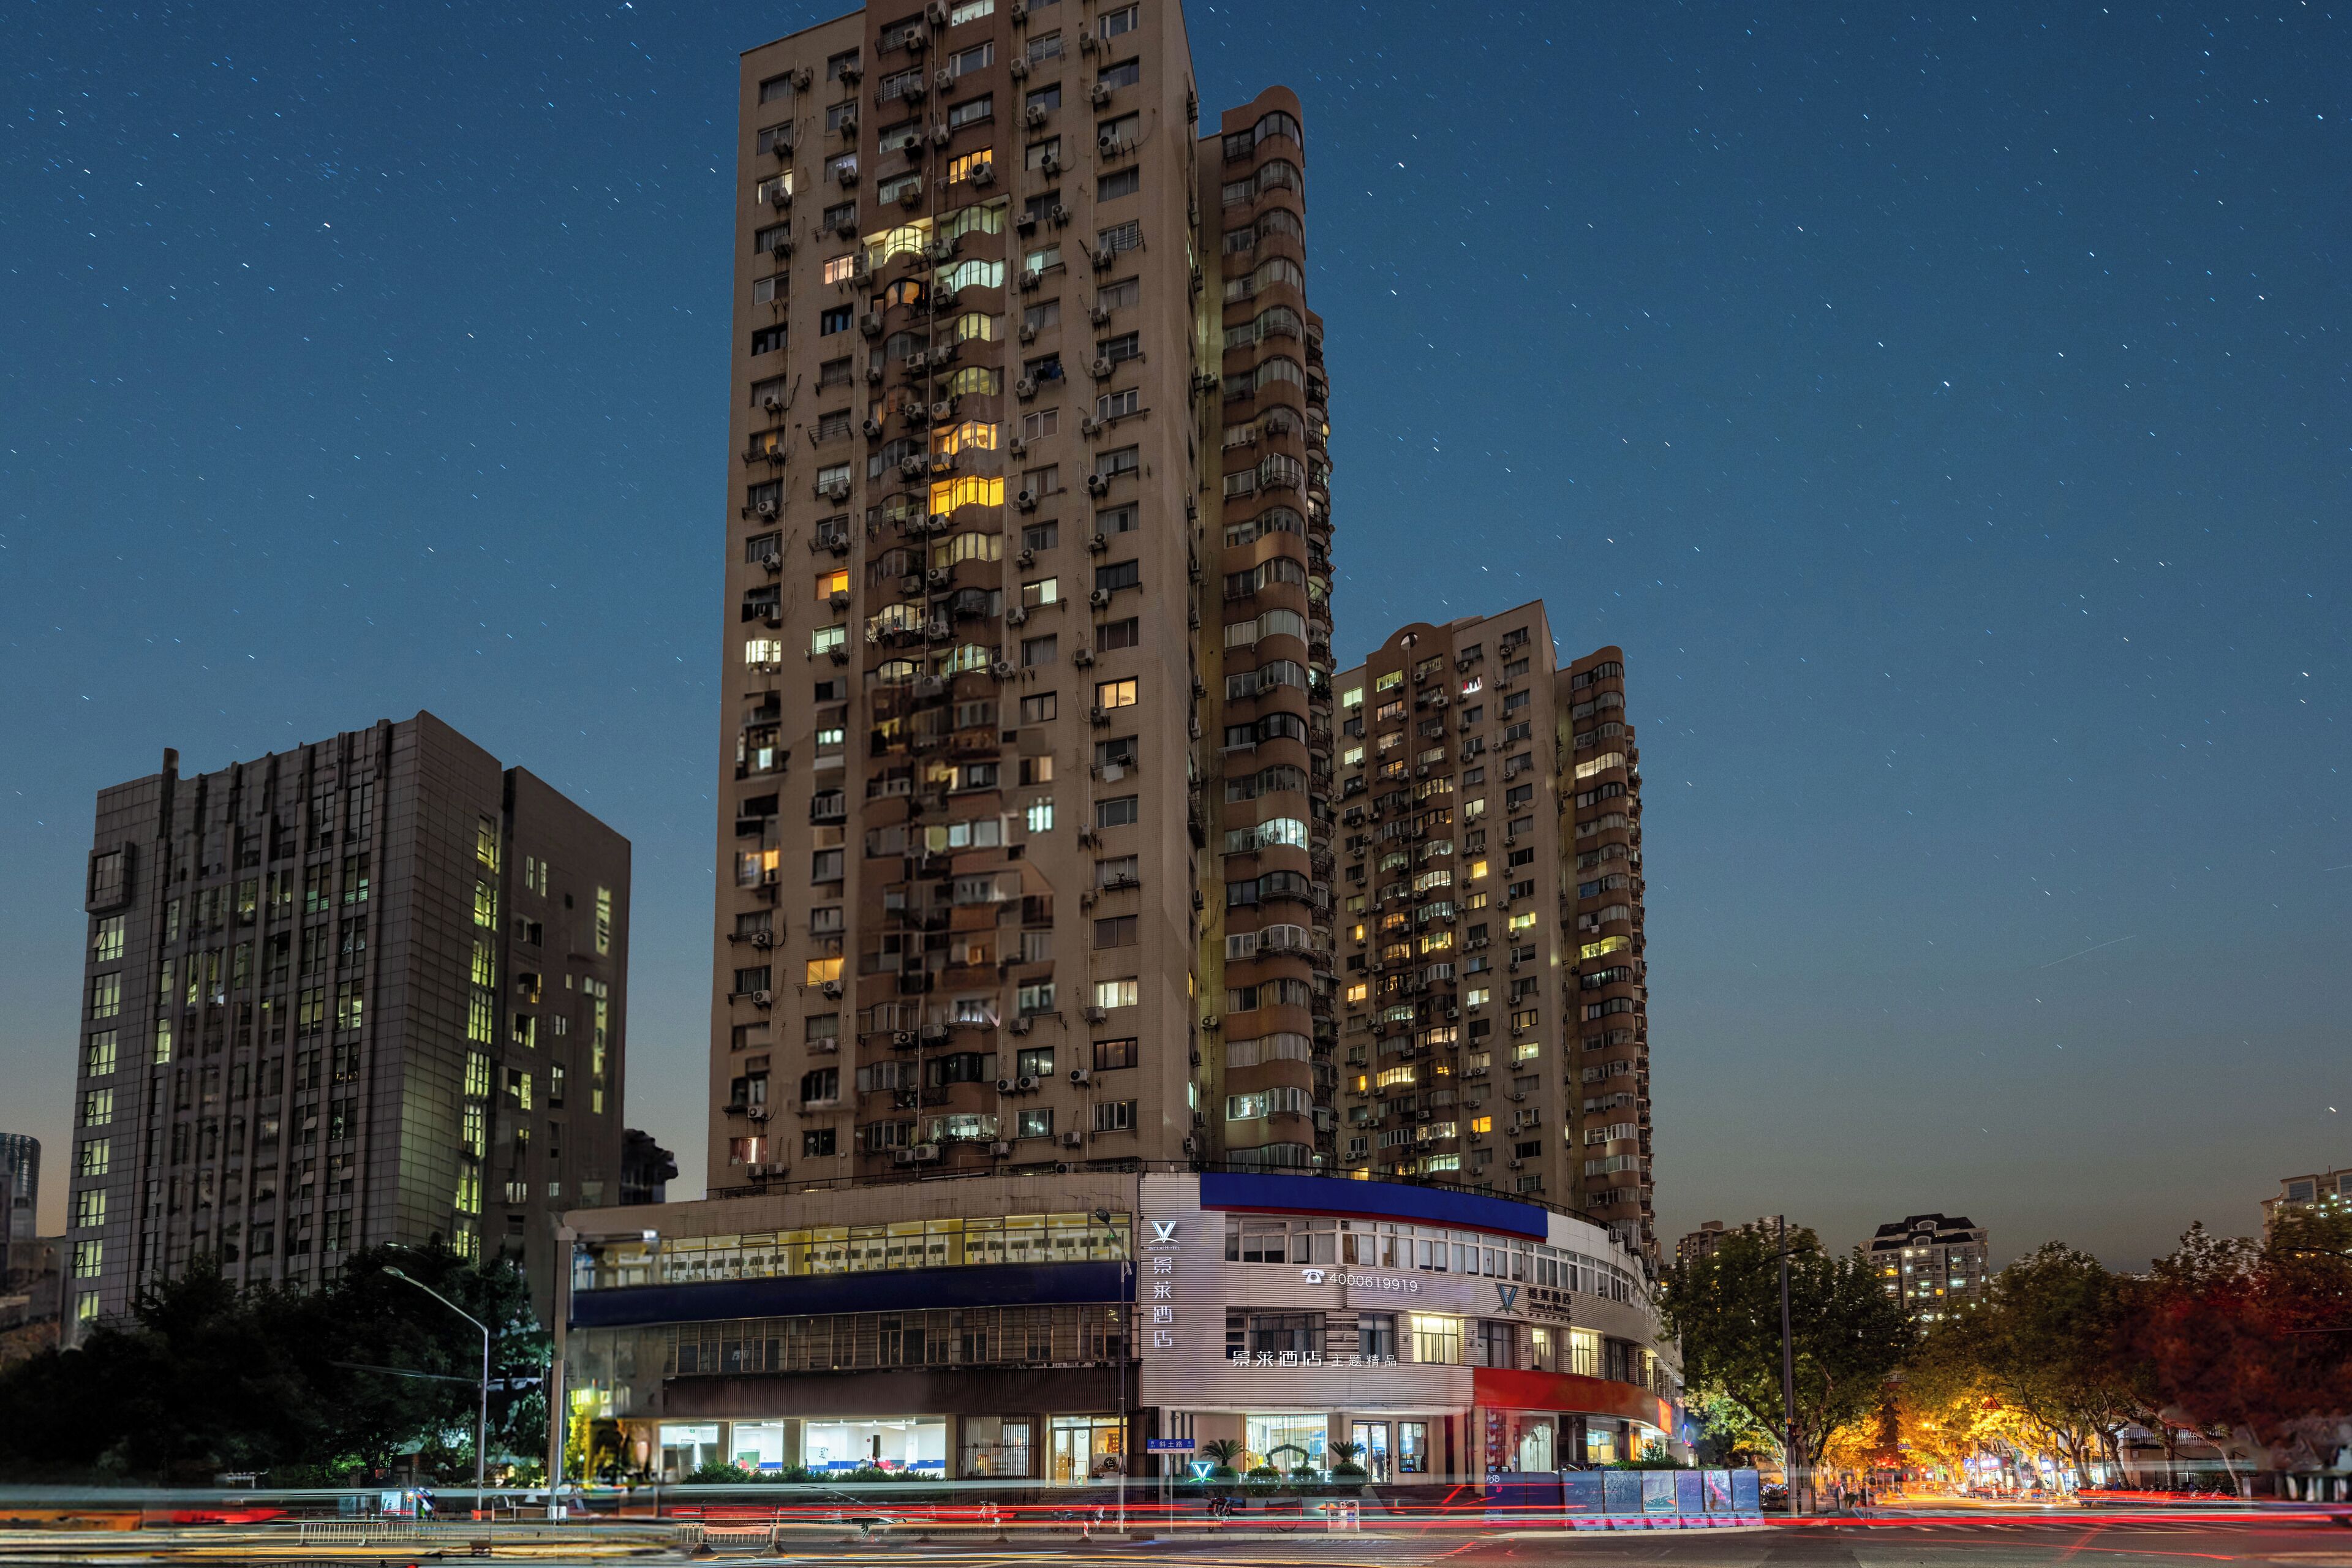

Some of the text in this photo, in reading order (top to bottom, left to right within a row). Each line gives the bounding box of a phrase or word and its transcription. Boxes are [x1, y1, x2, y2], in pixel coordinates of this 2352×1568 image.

[1329, 1273, 1417, 1292] 4000619919
[1154, 1257, 1172, 1348] 景莱酒店
[1232, 1351, 1396, 1367] 景莱酒店 主题精品
